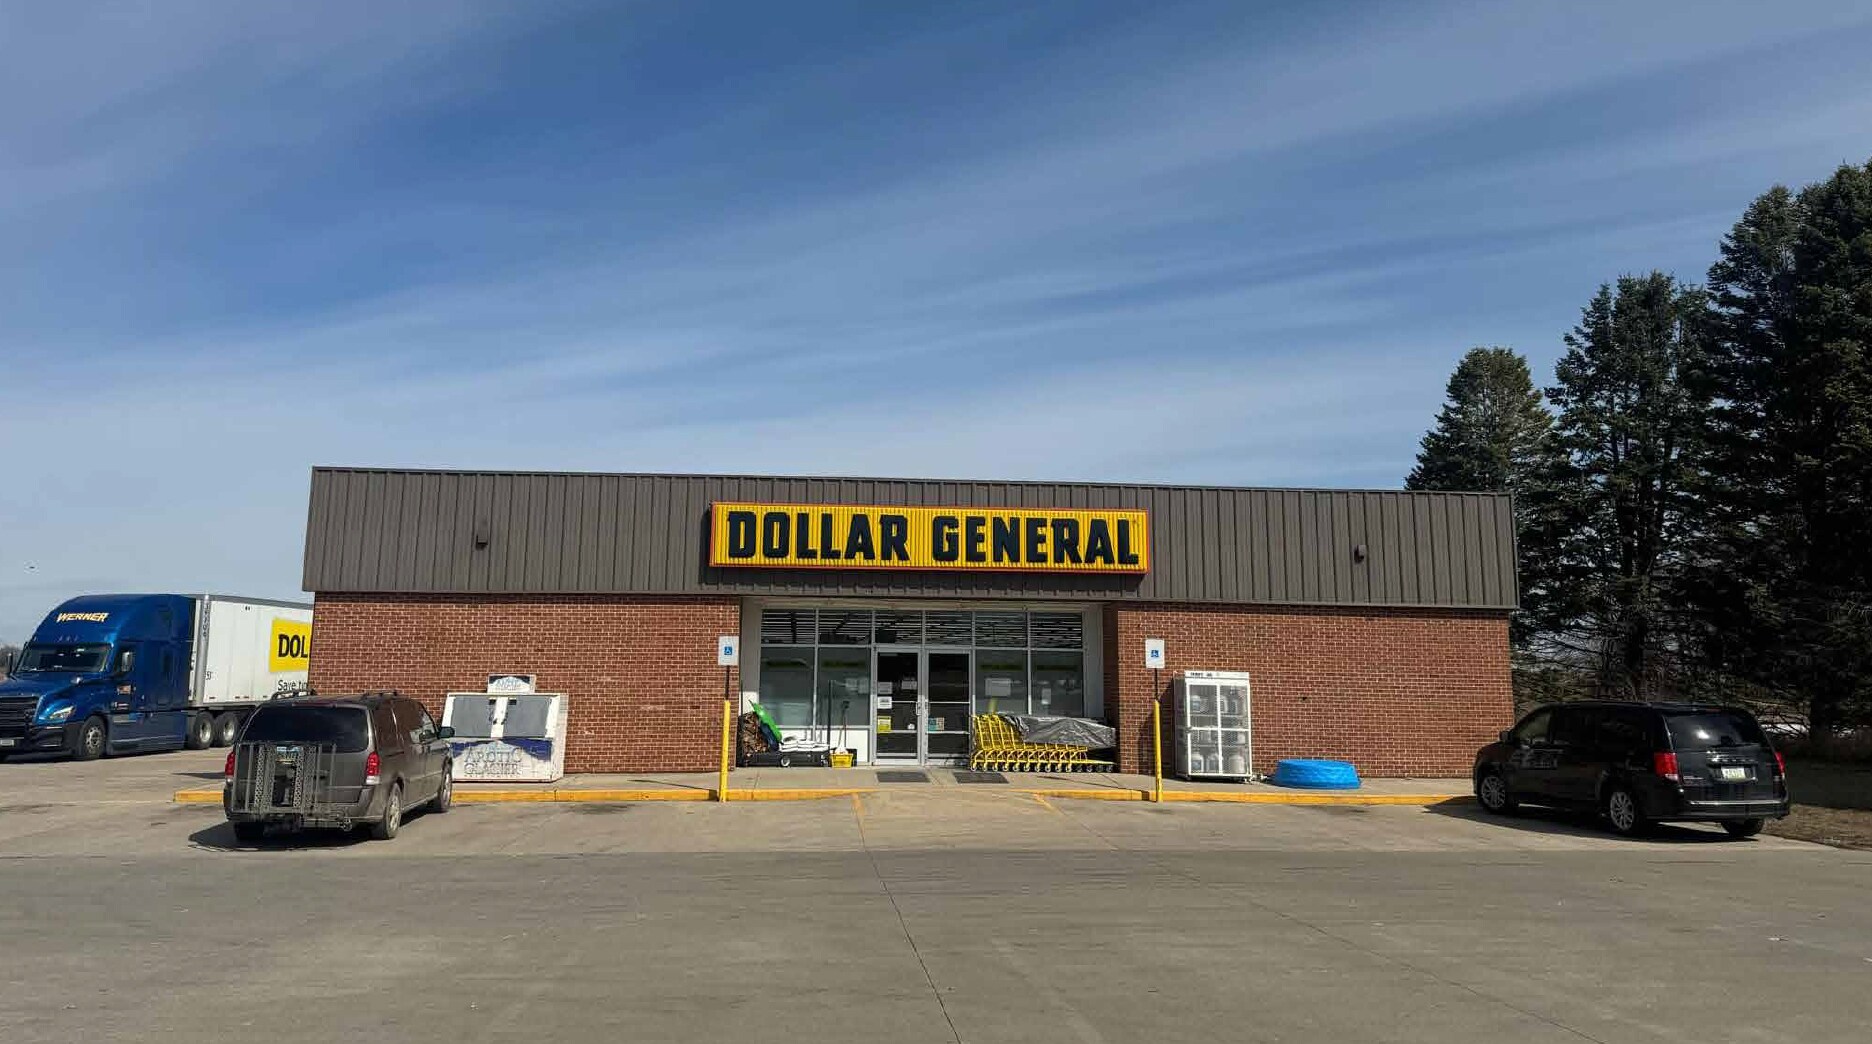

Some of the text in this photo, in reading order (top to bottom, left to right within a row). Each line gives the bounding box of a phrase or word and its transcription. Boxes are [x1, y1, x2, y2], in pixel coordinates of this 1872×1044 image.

[727, 511, 1139, 565] DOLLAR GENERAL
[56, 612, 109, 623] WERNER
[277, 679, 297, 691] Save
[464, 747, 523, 763] ARCTIC
